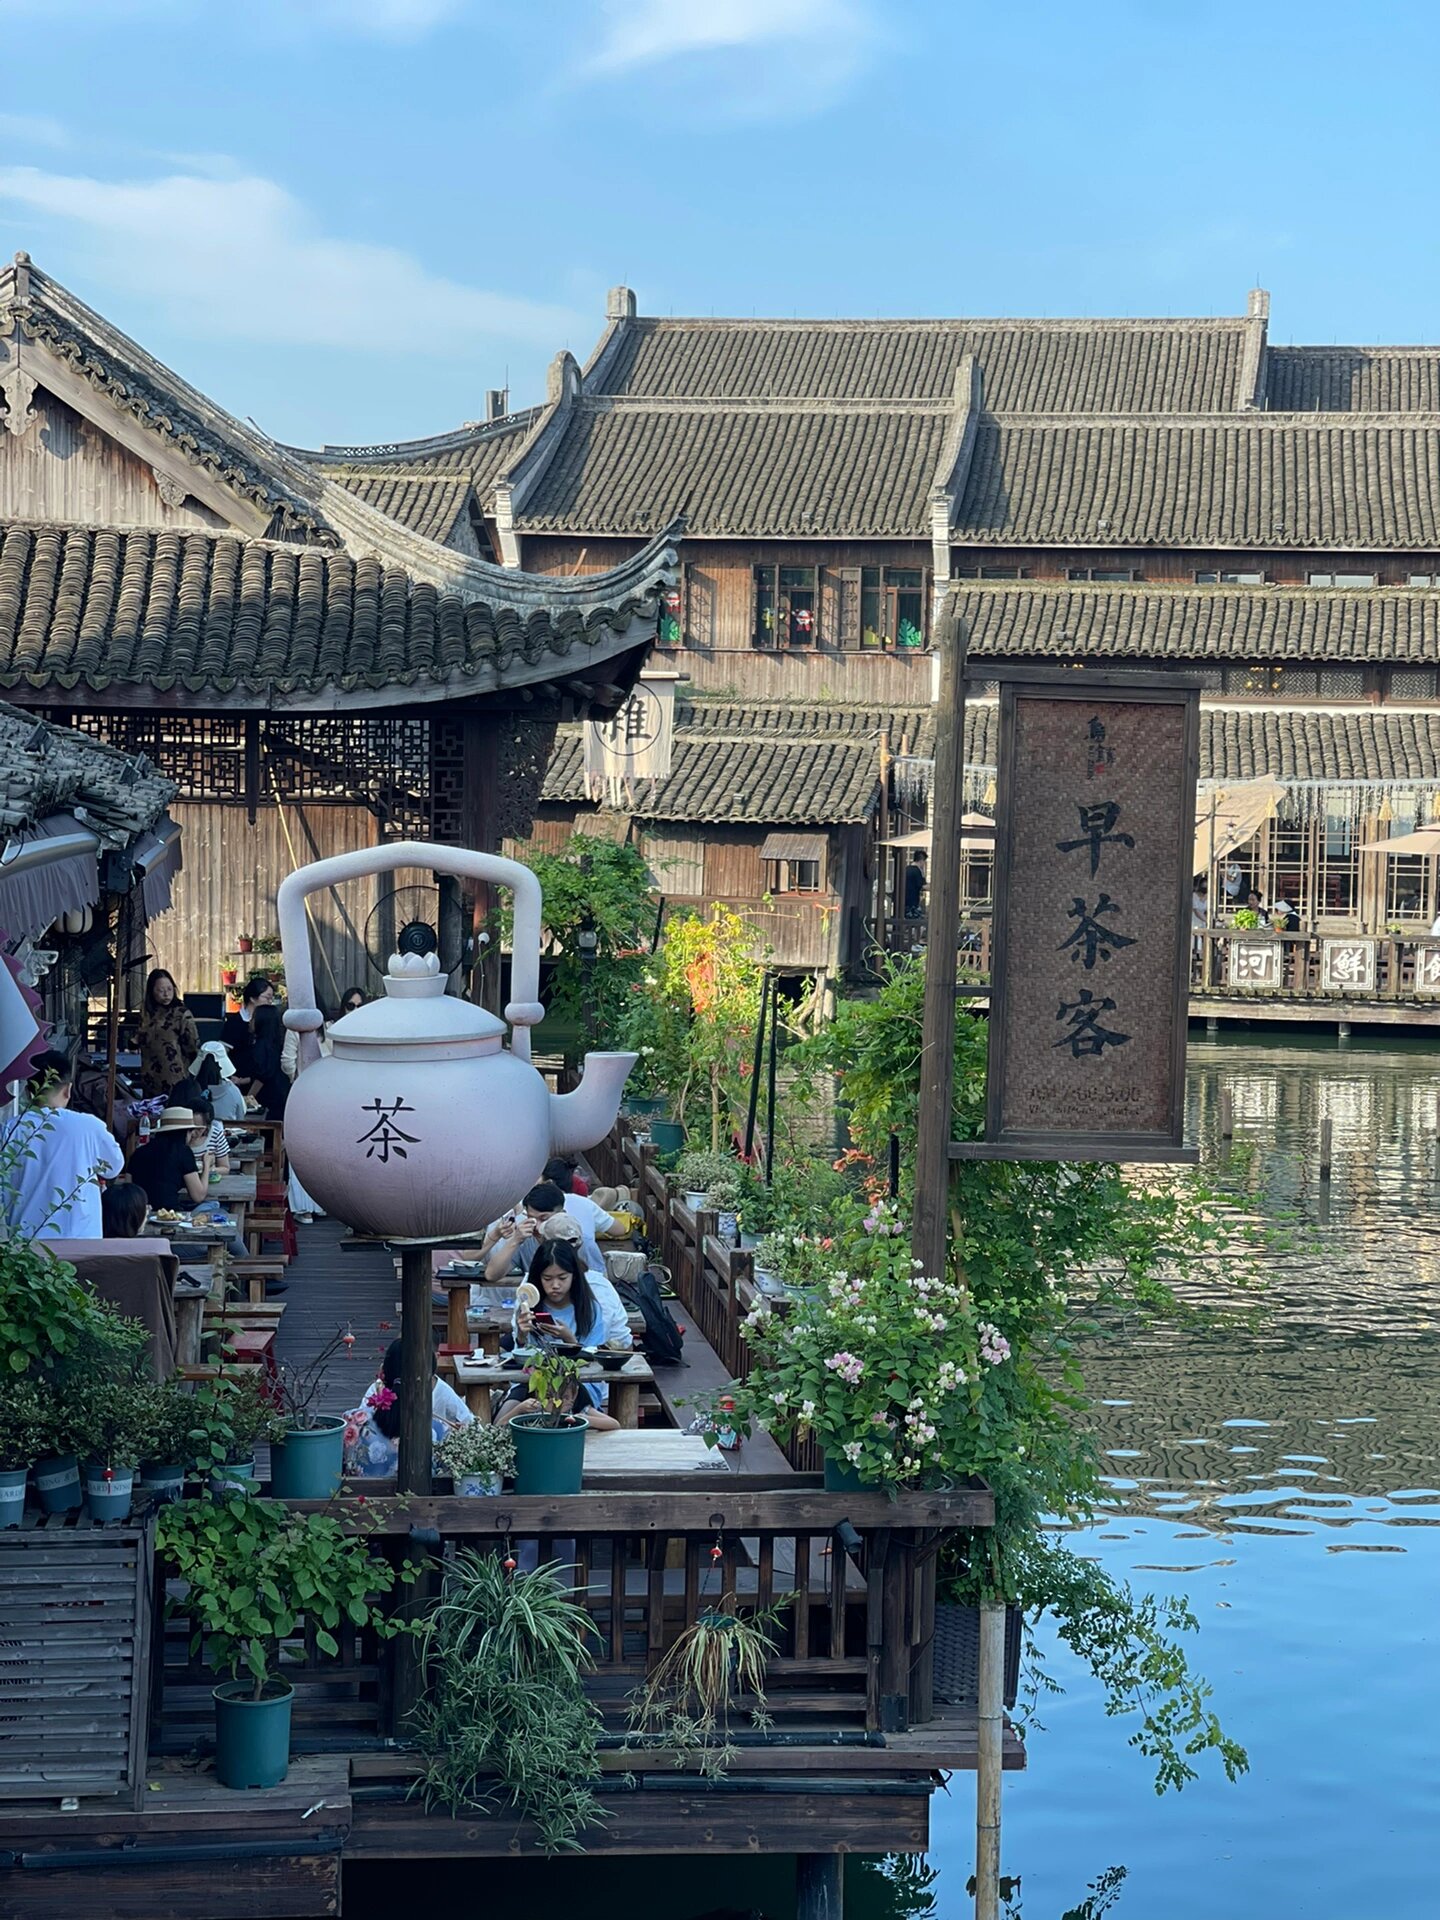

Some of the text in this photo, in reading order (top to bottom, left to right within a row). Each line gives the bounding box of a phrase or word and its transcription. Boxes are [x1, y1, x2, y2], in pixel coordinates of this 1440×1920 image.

[1051, 801, 1138, 1060] 早茶客
[356, 1096, 422, 1164] 茶
